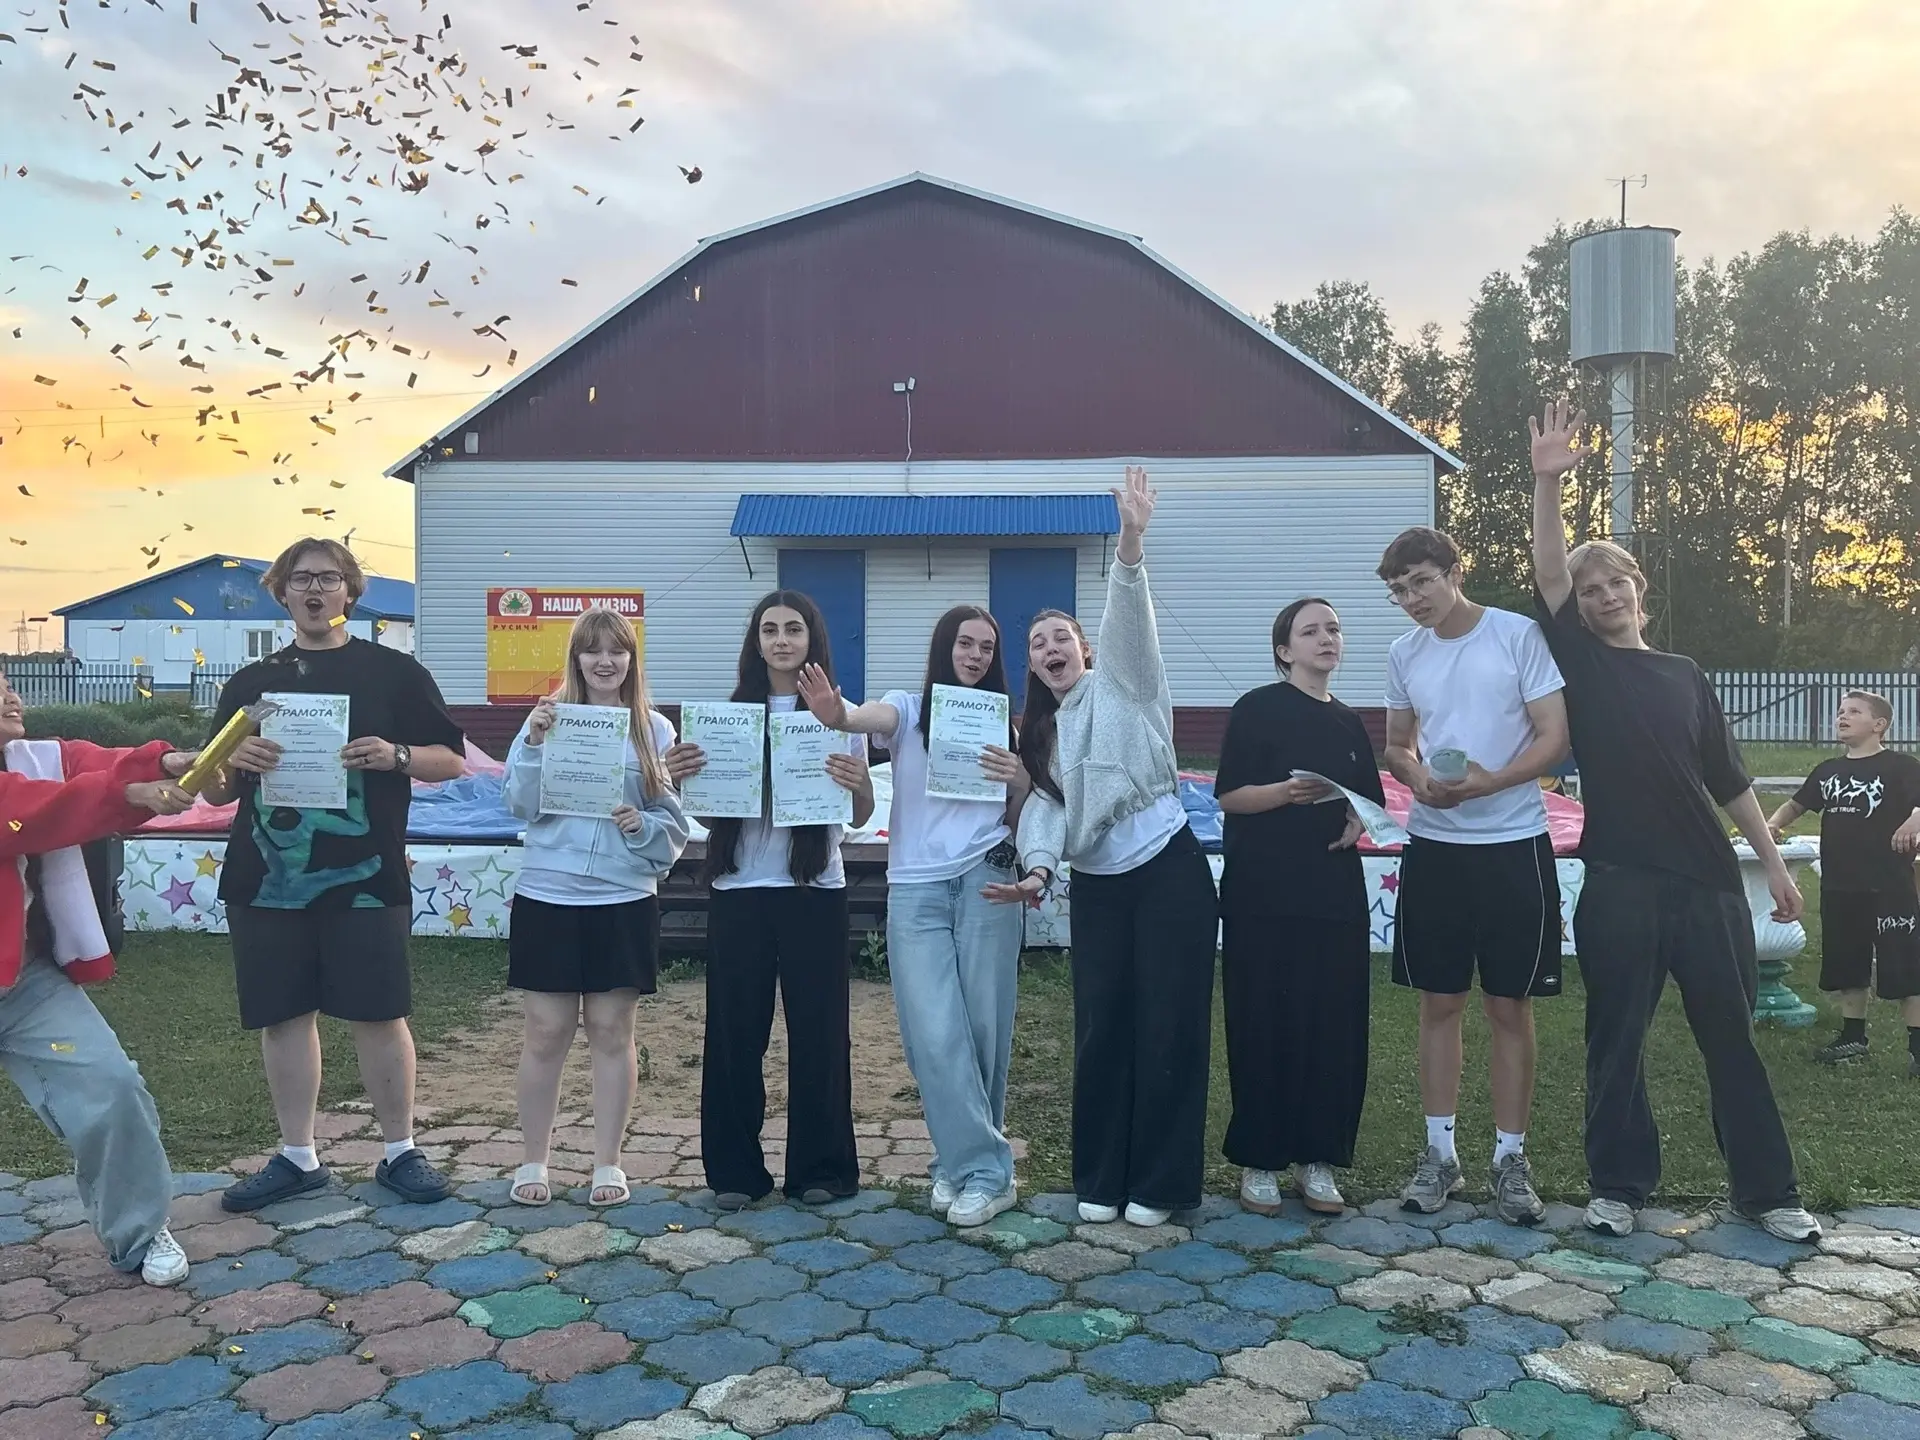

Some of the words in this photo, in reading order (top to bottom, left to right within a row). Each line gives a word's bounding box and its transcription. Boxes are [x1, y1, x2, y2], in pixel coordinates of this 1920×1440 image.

[543, 597, 584, 612] НАША
[589, 597, 638, 612] ЖИЗНЬ
[945, 699, 996, 713] ГРАМОТА
[275, 708, 333, 717] ГРАМОТА
[559, 718, 614, 729] ГРАМОТА
[697, 715, 749, 726] ГРАМОТА
